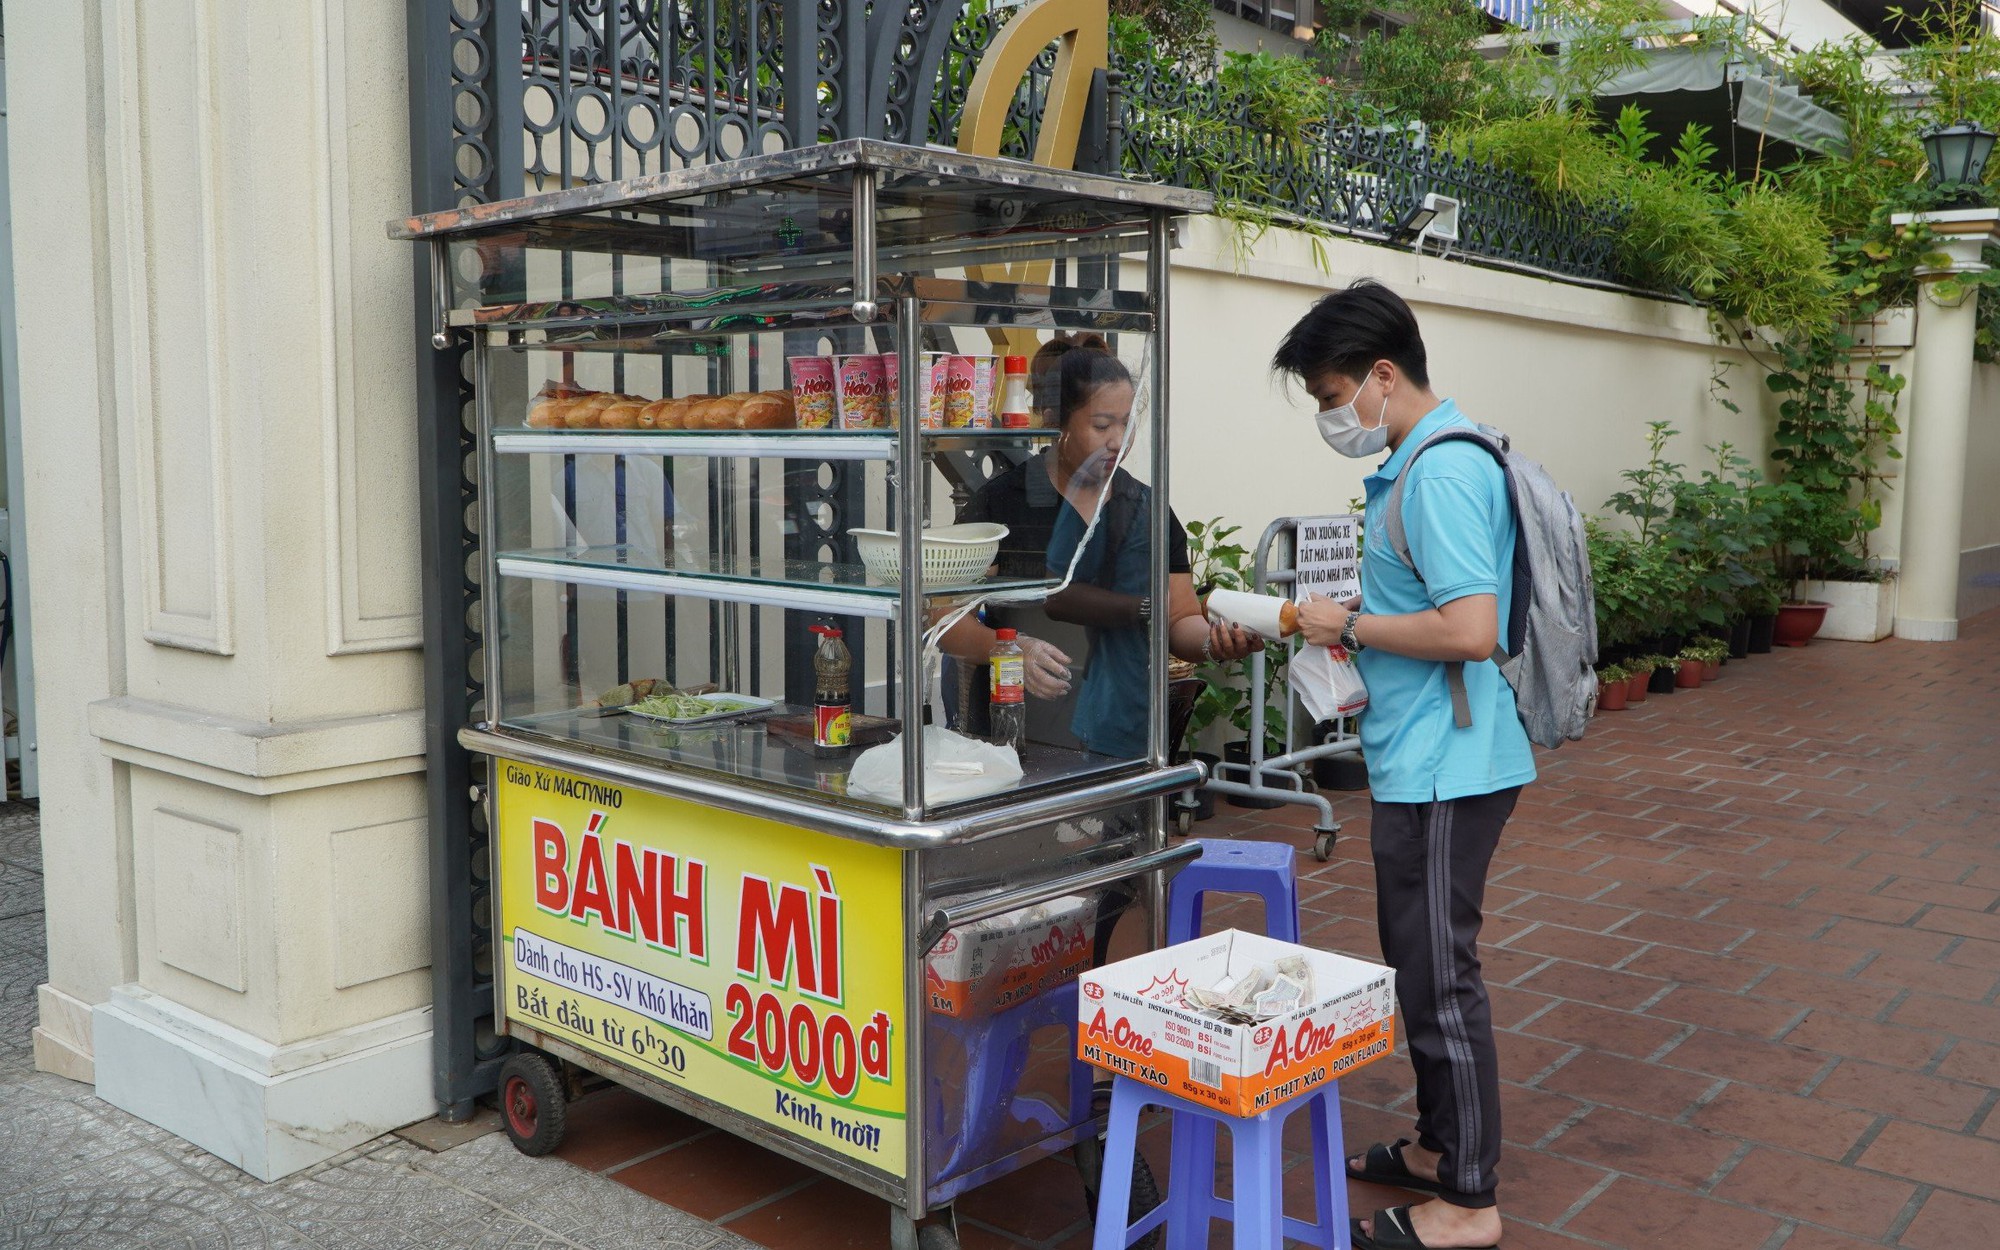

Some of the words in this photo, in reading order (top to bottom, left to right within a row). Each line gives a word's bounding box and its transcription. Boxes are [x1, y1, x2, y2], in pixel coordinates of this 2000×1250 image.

[804, 375, 833, 395] Hảo
[844, 377, 873, 397] Hảo
[1304, 526, 1317, 540] XIN
[1342, 525, 1351, 539] XE
[506, 765, 530, 787] Giáo
[534, 771, 551, 791] Xứ
[553, 776, 622, 809] MACTYNHO
[532, 811, 706, 962] BÁNH
[736, 862, 842, 1004] MÌ
[517, 937, 549, 973] Dành
[554, 951, 577, 983] cho
[637, 980, 666, 1015] Khó
[670, 990, 709, 1032] khăn
[1322, 997, 1342, 1010] INSTANT
[1342, 988, 1363, 1001] NOODLES
[517, 984, 550, 1019] Bắt
[556, 998, 595, 1036] đầu
[601, 1017, 625, 1047] từ
[631, 1025, 686, 1073] 6h30
[1087, 1006, 1153, 1056] A-One
[1148, 1002, 1173, 1016] INSTANT
[1174, 1011, 1202, 1026] NOODLES
[1165, 1020, 1175, 1032] ISO
[1176, 1024, 1191, 1037] 9001
[725, 982, 891, 1099] 2000đ
[1164, 1032, 1175, 1043] ISO
[1175, 1035, 1194, 1050] 22000
[1264, 1017, 1336, 1078] A-One
[1341, 1041, 1353, 1051] 85g
[1359, 1034, 1367, 1043] 30
[1084, 1044, 1101, 1061] MÌ
[1104, 1051, 1137, 1075] THỊT
[1140, 1065, 1168, 1086] XÀO
[1255, 1087, 1270, 1109] MÌ
[1273, 1078, 1301, 1098] THỊT
[1303, 1066, 1325, 1088] XÀO
[1333, 1053, 1356, 1073] PORK
[1357, 1038, 1388, 1062] FLAVOR
[1182, 1081, 1198, 1095] 85g
[1206, 1089, 1217, 1100] 30
[1218, 1095, 1231, 1106] gói
[775, 1088, 823, 1132] Kính
[830, 1116, 881, 1153] mời!
